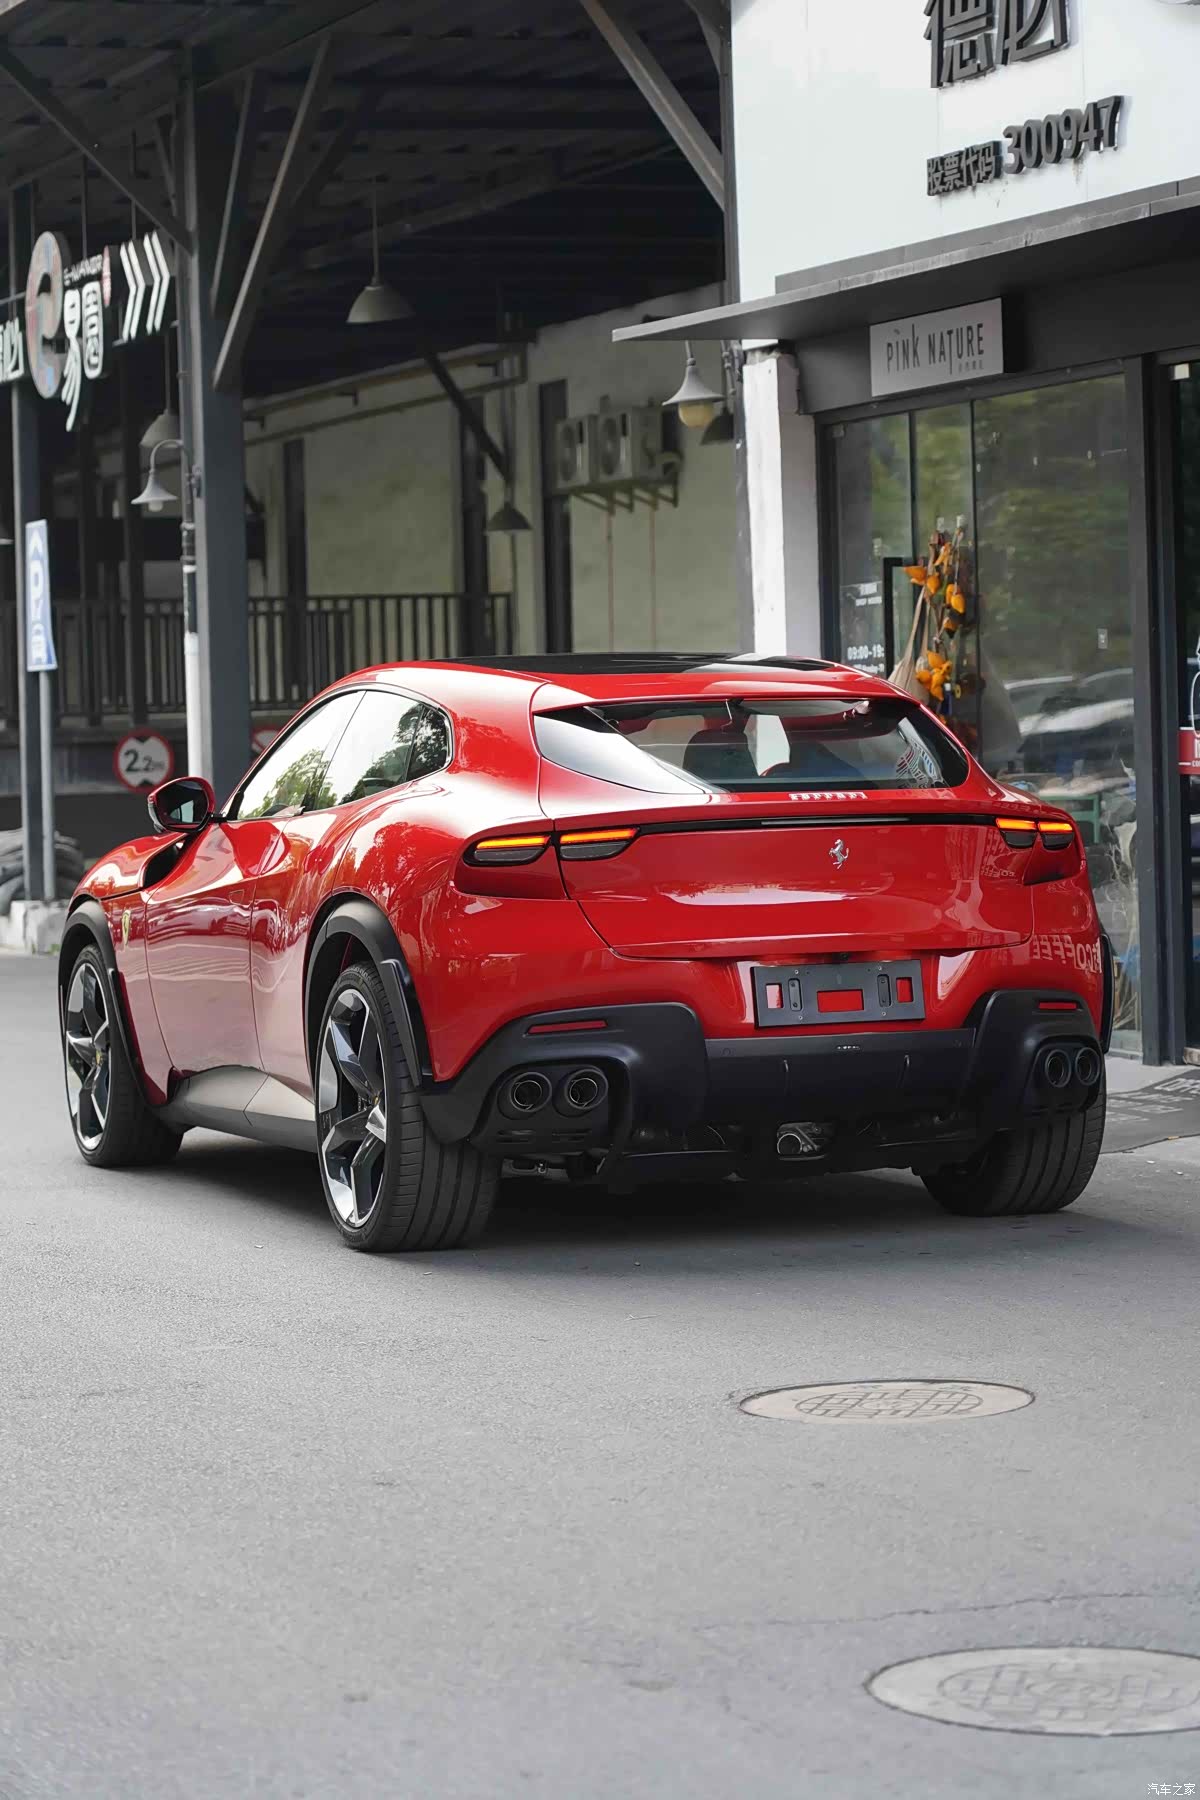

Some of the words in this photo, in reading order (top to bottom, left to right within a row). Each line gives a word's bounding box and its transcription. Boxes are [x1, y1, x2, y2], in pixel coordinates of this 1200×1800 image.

[926, 140, 1001, 196] 股票代码
[1002, 95, 1124, 175] 300947
[927, 322, 985, 375] NATURE
